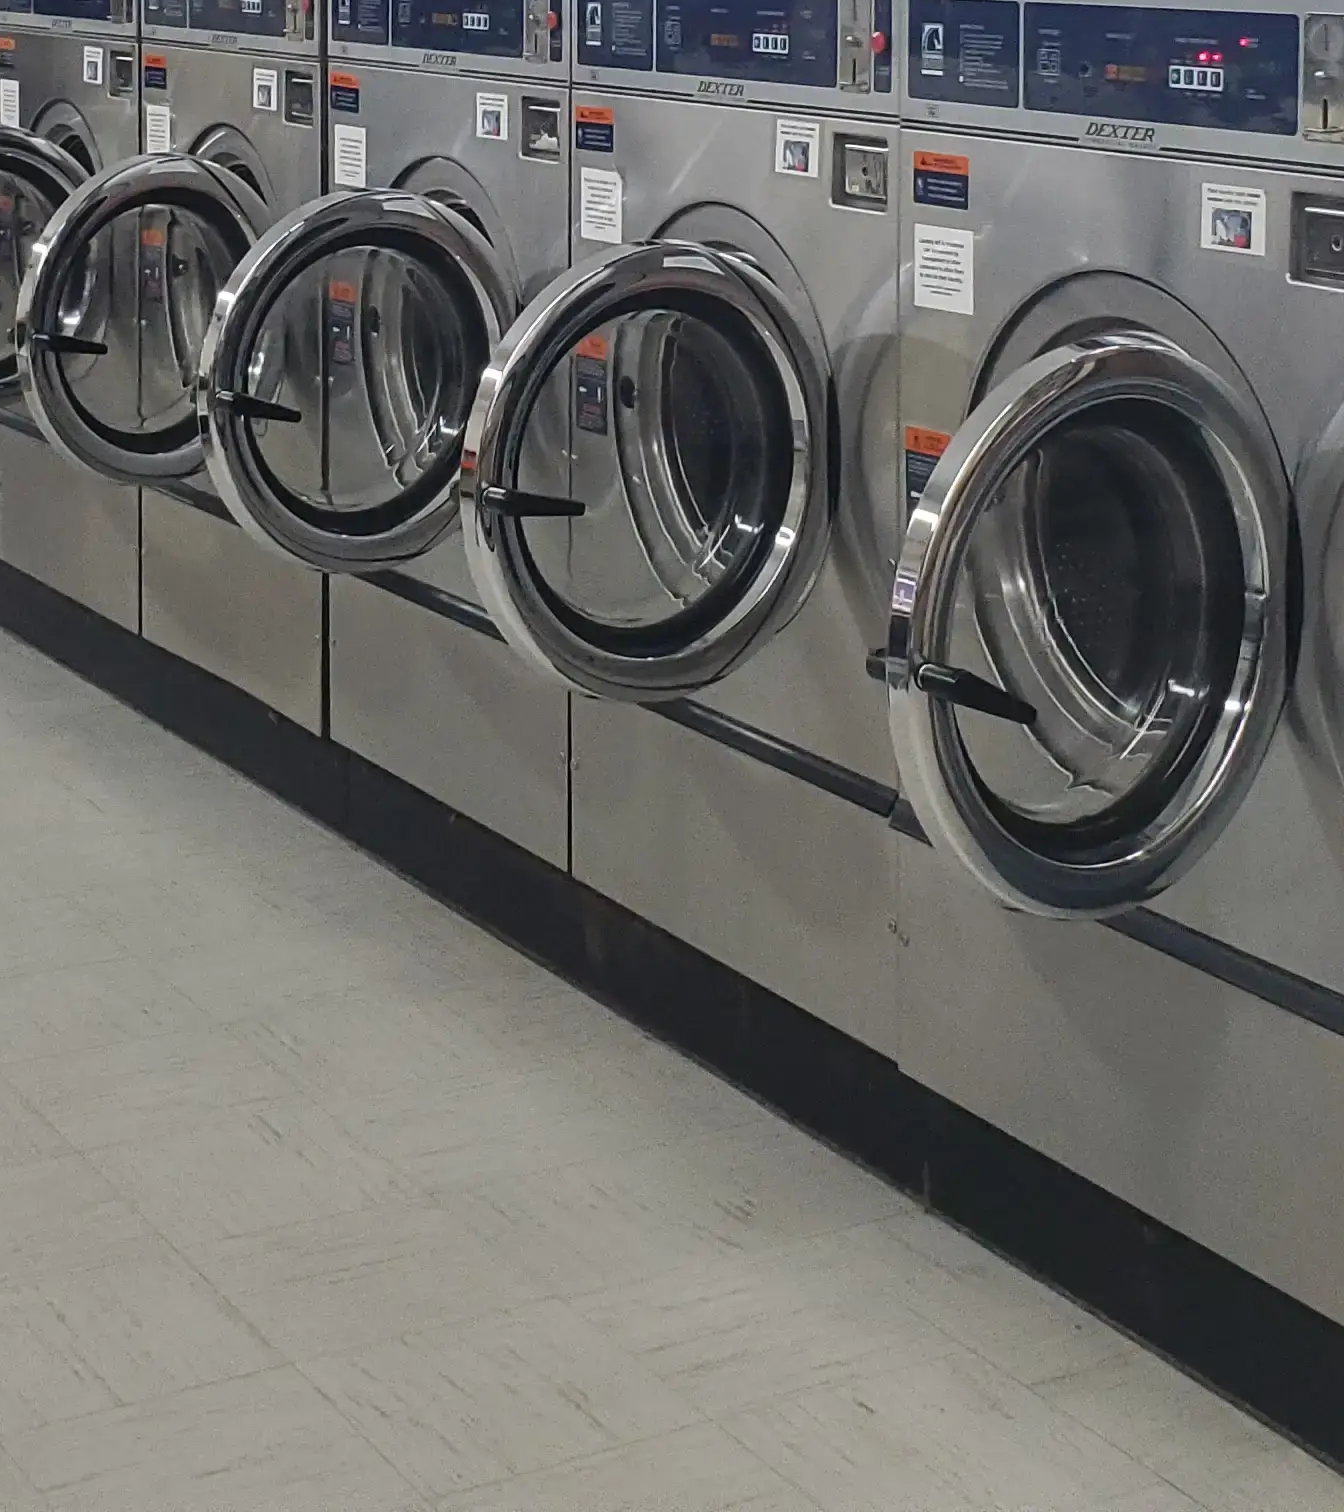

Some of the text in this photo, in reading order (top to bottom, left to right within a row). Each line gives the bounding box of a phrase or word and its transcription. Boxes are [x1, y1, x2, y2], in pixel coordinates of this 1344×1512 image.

[422, 54, 457, 66] DEXTER
[696, 80, 744, 96] DEXTER
[1085, 122, 1156, 142] DEXTER
